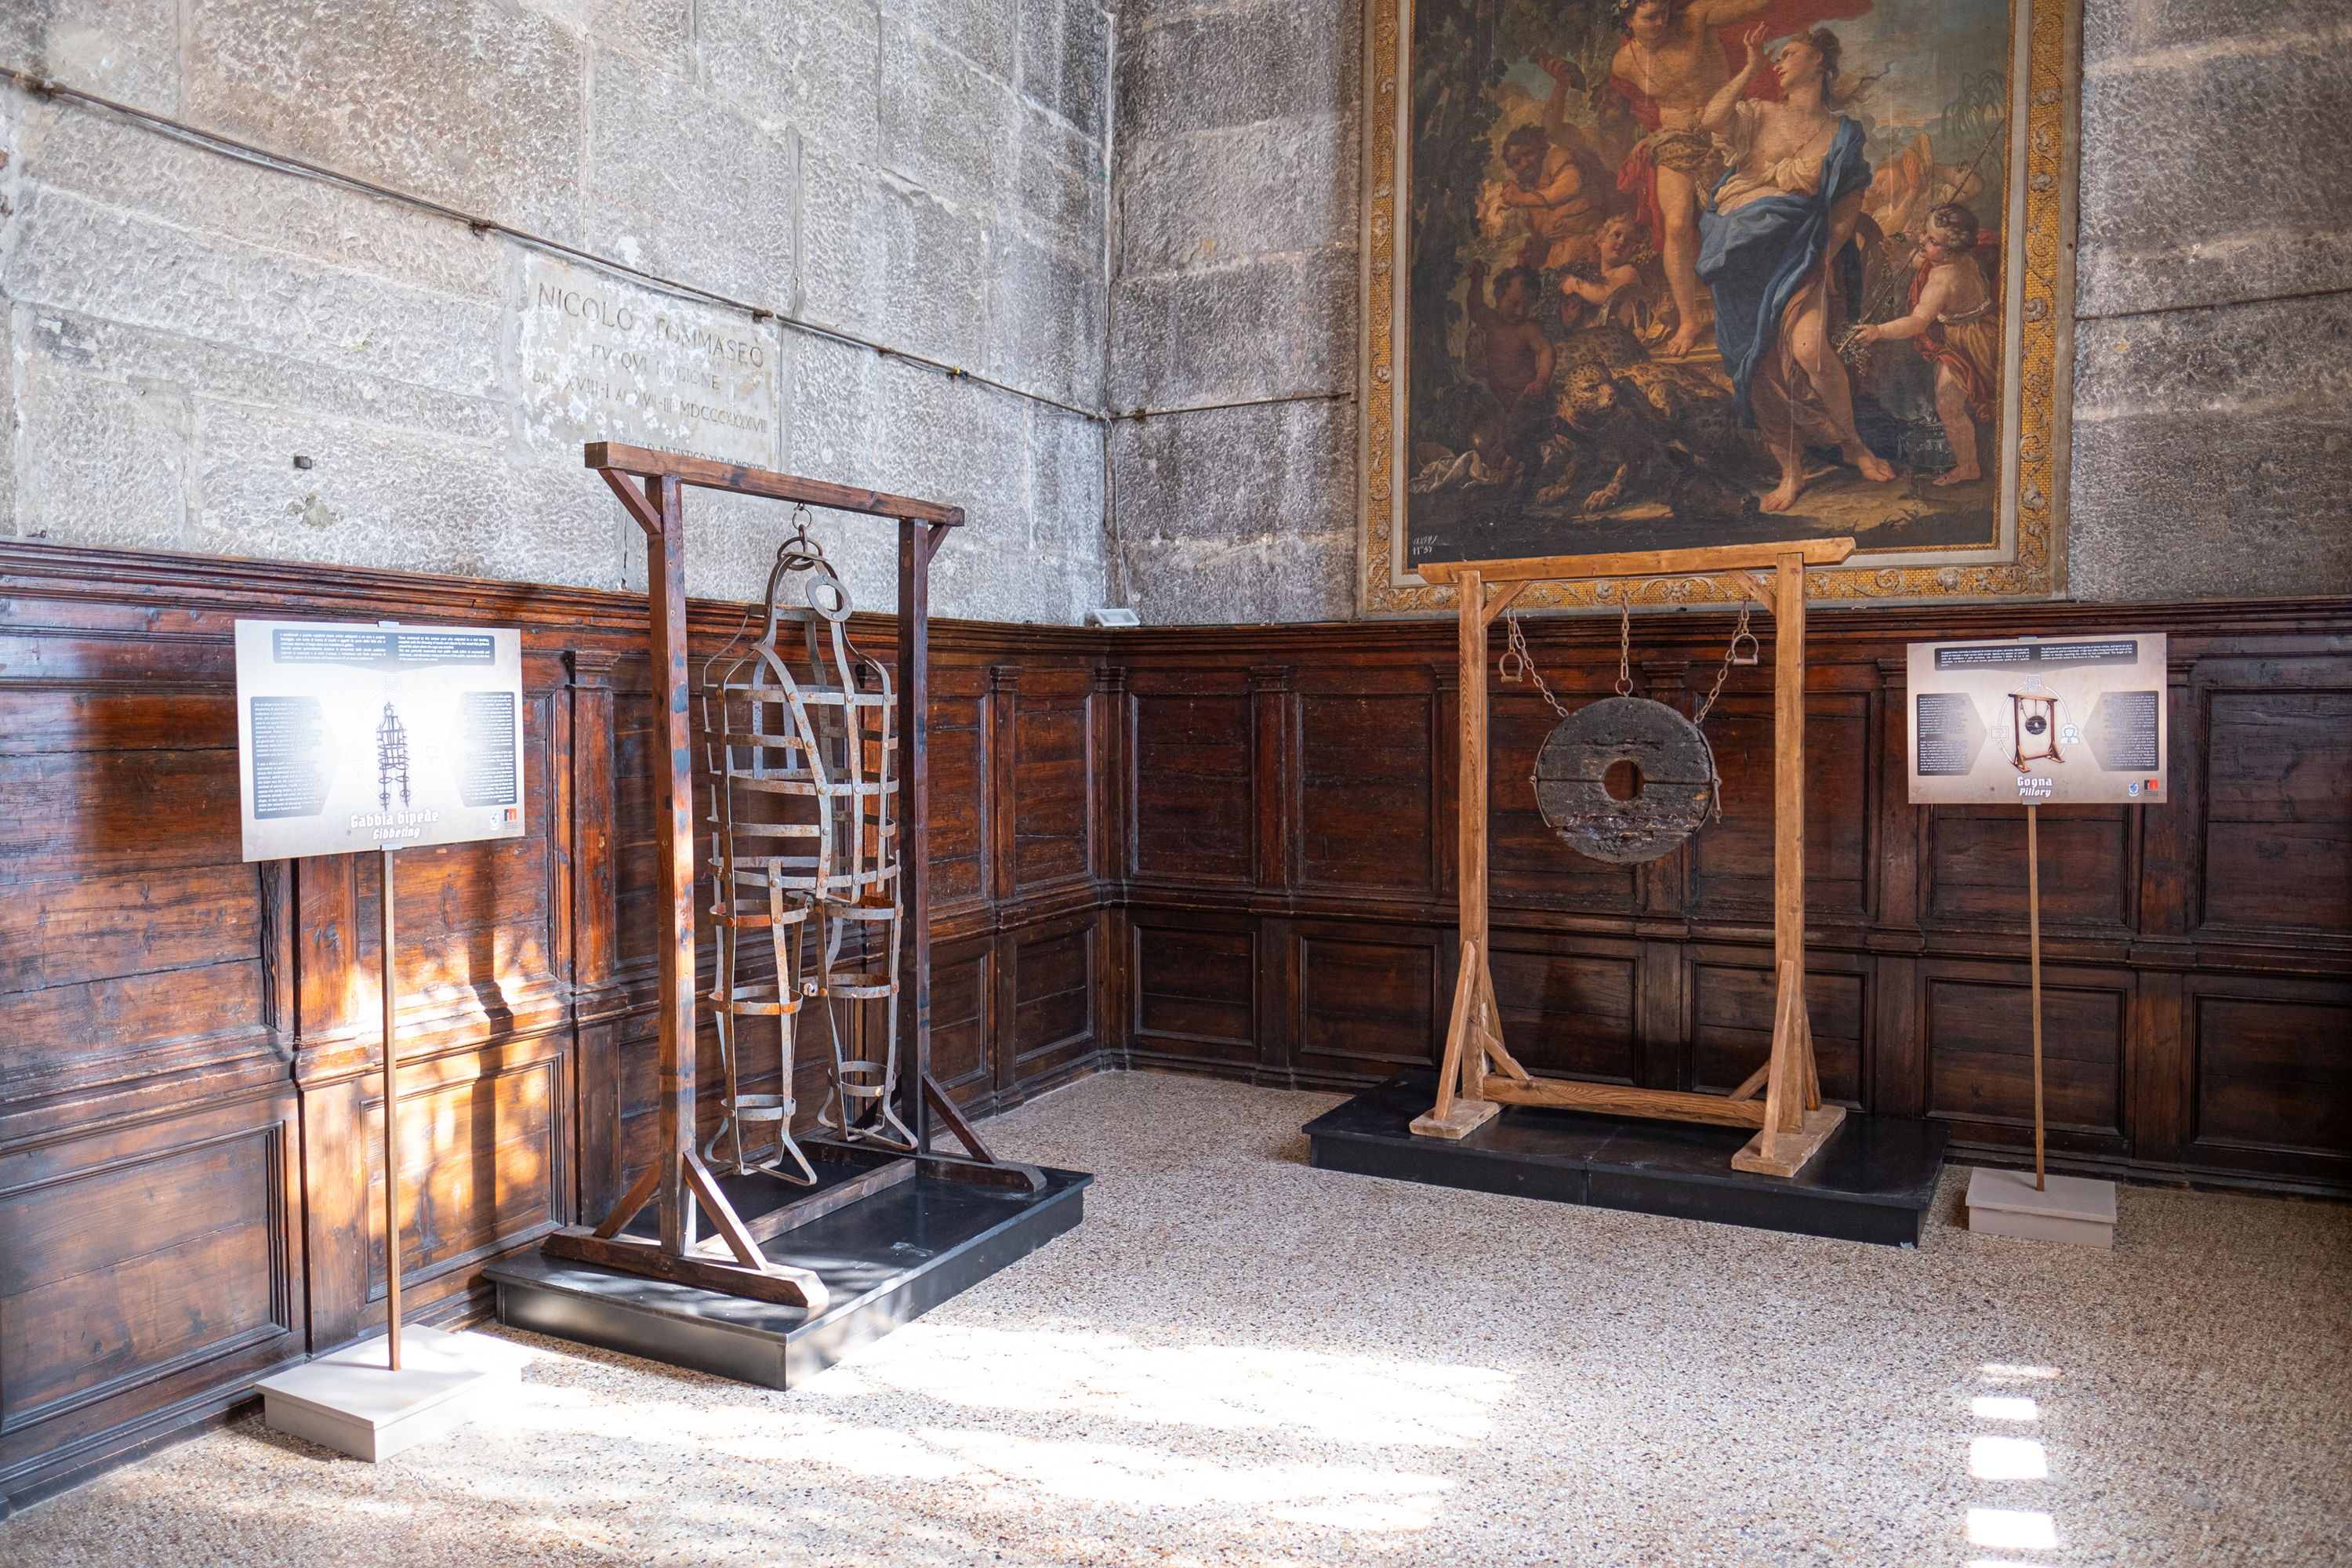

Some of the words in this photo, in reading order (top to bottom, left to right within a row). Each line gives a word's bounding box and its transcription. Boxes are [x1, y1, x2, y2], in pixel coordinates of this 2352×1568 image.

[539, 282, 633, 331] NICOLO
[621, 352, 647, 372] QVI
[2017, 776, 2053, 789] Gogna
[2019, 787, 2052, 797] Pillory
[350, 812, 394, 828] Gabbia
[397, 809, 438, 826] bipede
[372, 826, 420, 840] Gibbeting
